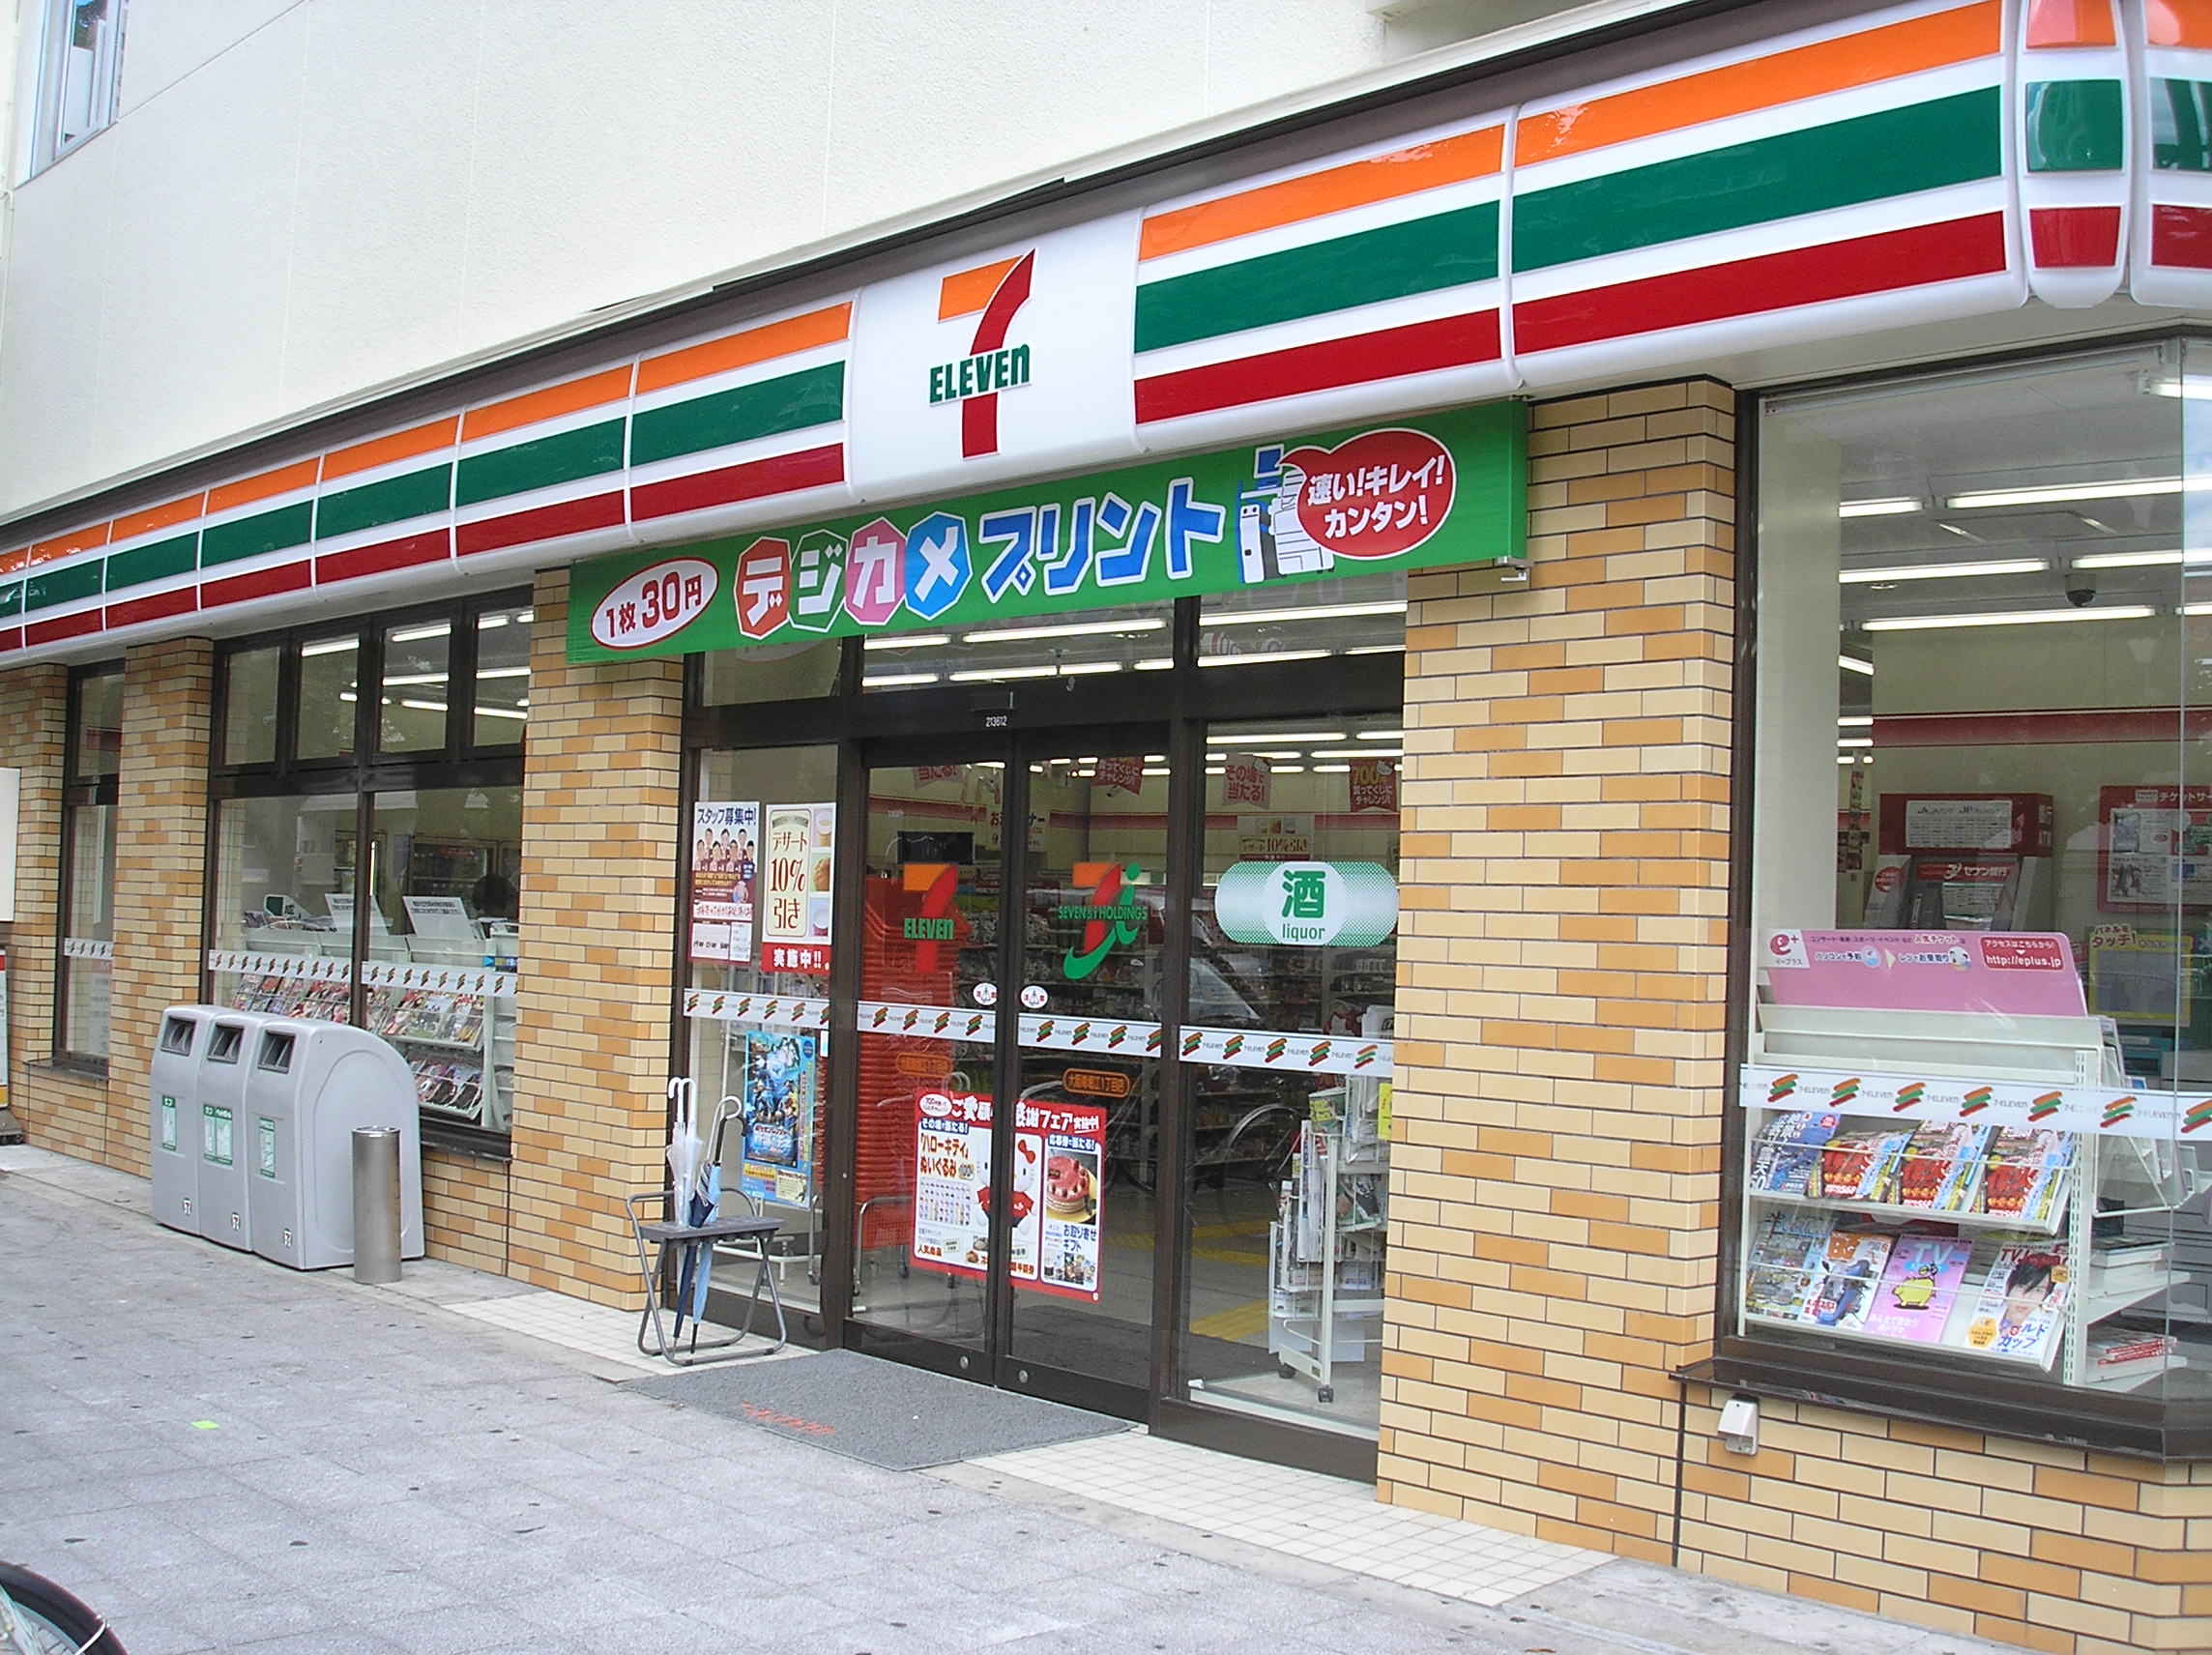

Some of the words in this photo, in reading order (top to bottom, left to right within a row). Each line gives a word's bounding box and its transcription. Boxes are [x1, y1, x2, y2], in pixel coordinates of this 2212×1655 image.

[1324, 494, 1429, 539] カンタン!
[605, 571, 703, 639] 1枚30円
[773, 831, 808, 852] デザート
[771, 857, 806, 893] 10%
[1282, 870, 1325, 918] 酒
[772, 897, 801, 930] 引き
[1282, 923, 1325, 942] liquor
[1986, 954, 2062, 968] http://eplus.jp
